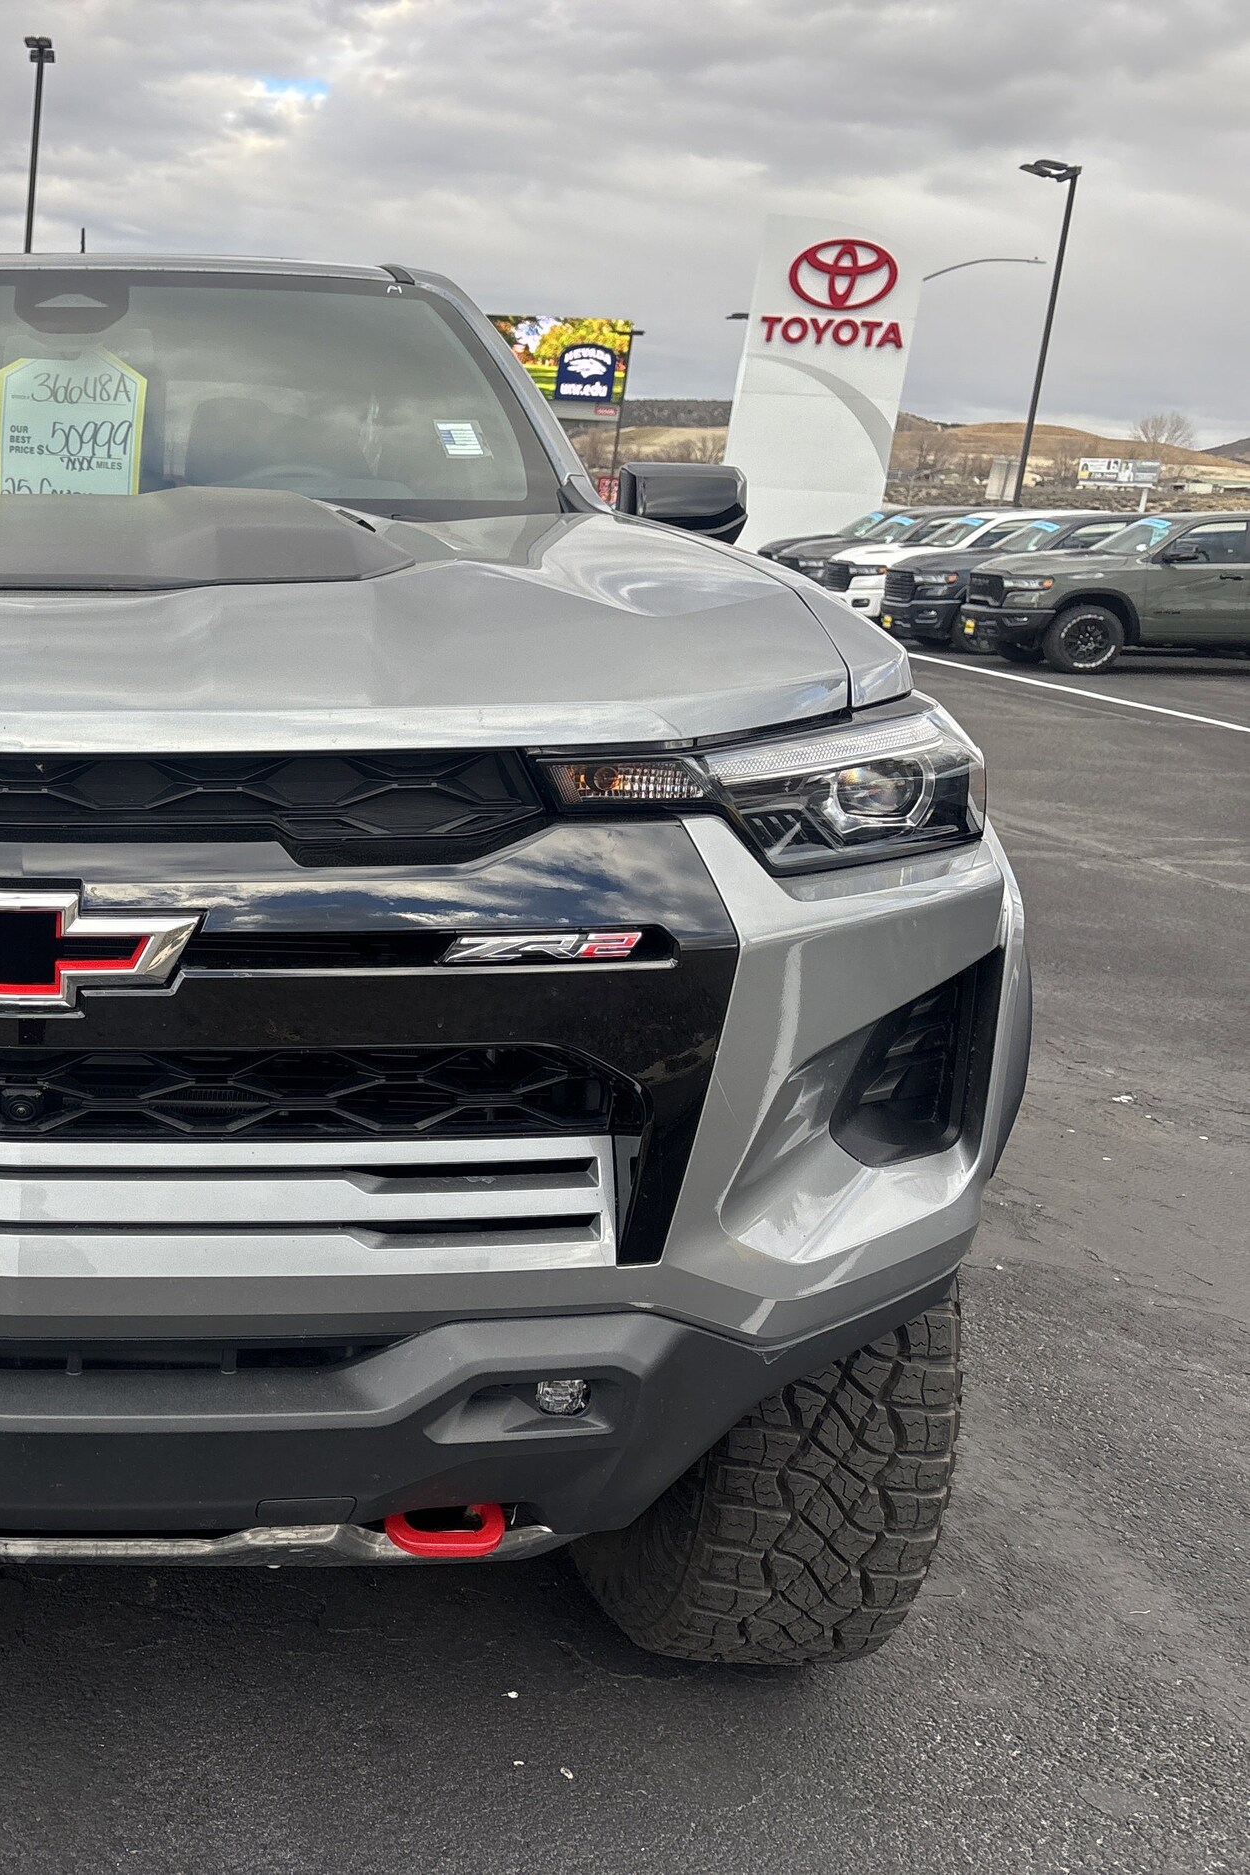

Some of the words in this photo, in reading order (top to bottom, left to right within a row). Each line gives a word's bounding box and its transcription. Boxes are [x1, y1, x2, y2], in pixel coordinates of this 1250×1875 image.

[761, 316, 903, 349] TOYOTA
[563, 347, 612, 366] NEVADA
[560, 381, 608, 397] unr.edu
[10, 424, 29, 433] OUR
[9, 436, 31, 444] BEST
[9, 445, 35, 455] PRICE
[96, 461, 123, 470] MILES
[444, 931, 643, 963] ZR2
